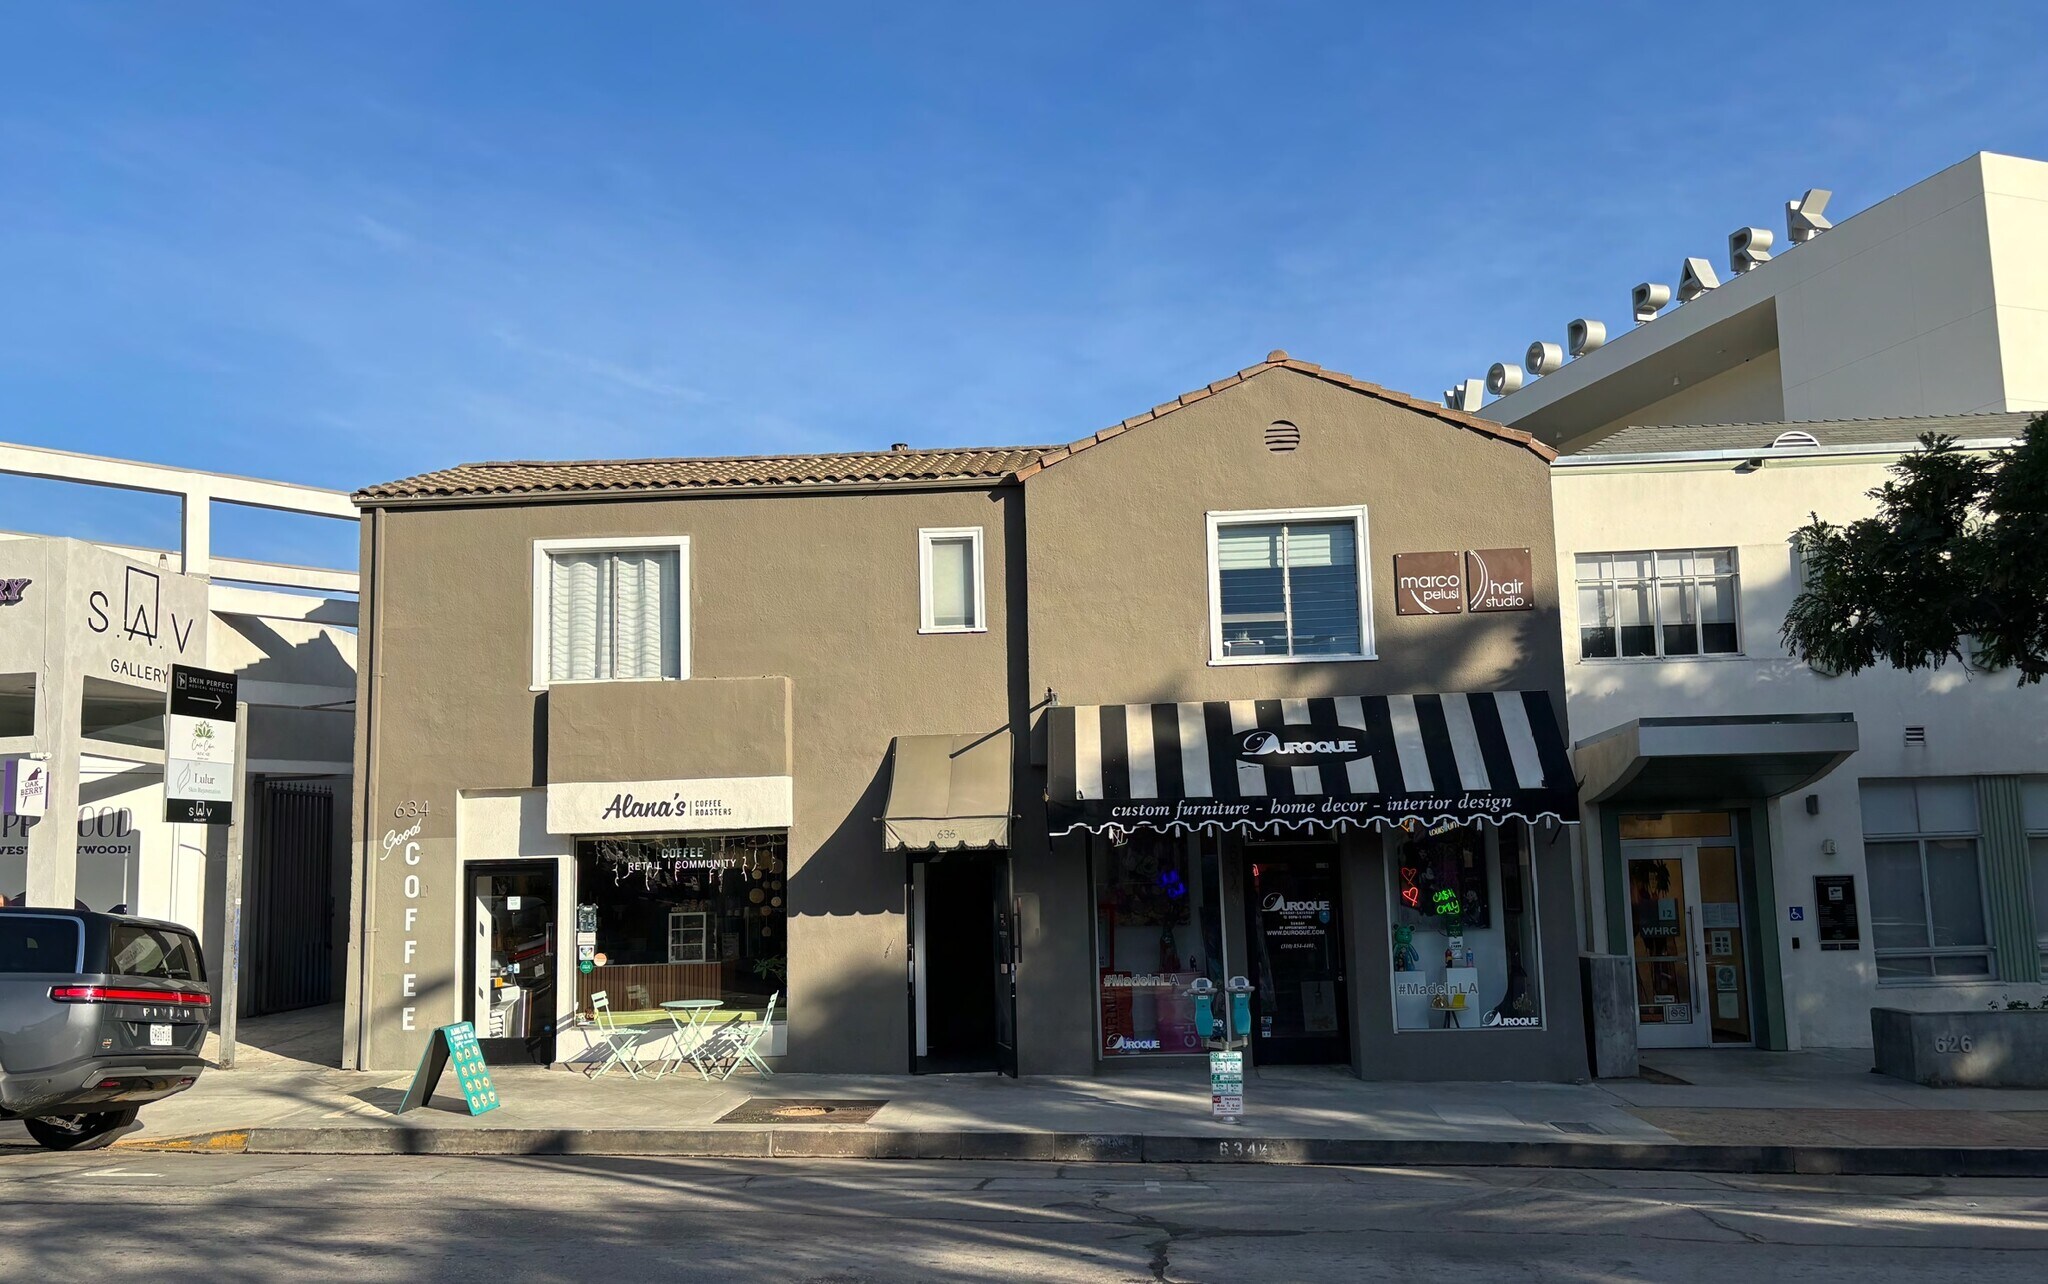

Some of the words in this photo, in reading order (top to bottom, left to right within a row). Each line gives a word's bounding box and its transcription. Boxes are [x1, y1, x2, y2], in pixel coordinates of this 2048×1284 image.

[1401, 575, 1460, 589] marco
[1490, 579, 1524, 595] hair
[1423, 588, 1459, 602] pelusi
[1485, 596, 1525, 607] studio
[111, 658, 170, 684] GALLERY
[189, 676, 204, 685] SKIN
[206, 679, 234, 690] PERFECT
[1241, 731, 1358, 756] DUROQUE
[24, 780, 39, 789] OAK
[194, 773, 216, 785] Lulur
[20, 785, 44, 797] BERRY
[394, 800, 430, 818] 634
[602, 792, 687, 820] Alana's
[695, 799, 722, 808] COFFEE
[1111, 804, 1170, 817] custom
[1175, 799, 1250, 820] furniture
[1270, 798, 1315, 815] home
[1321, 796, 1367, 813] decor
[1386, 794, 1453, 812] interior
[1457, 793, 1513, 812] design
[695, 808, 732, 817] ROASTERS
[380, 818, 422, 862] Good
[936, 829, 957, 840] 636
[661, 847, 704, 859] COFFEE
[628, 861, 662, 872] RETAIL
[675, 858, 737, 870] COMMUNITY
[1261, 892, 1331, 912] DUROQUE
[402, 841, 421, 1032] COFFEE
[1642, 926, 1678, 936] WHRC
[1398, 982, 1479, 996] #MadeInLA
[1481, 1010, 1540, 1027] DUROQUE
[1105, 1032, 1161, 1050] DUROQUE
[1935, 1034, 1974, 1053] 626
